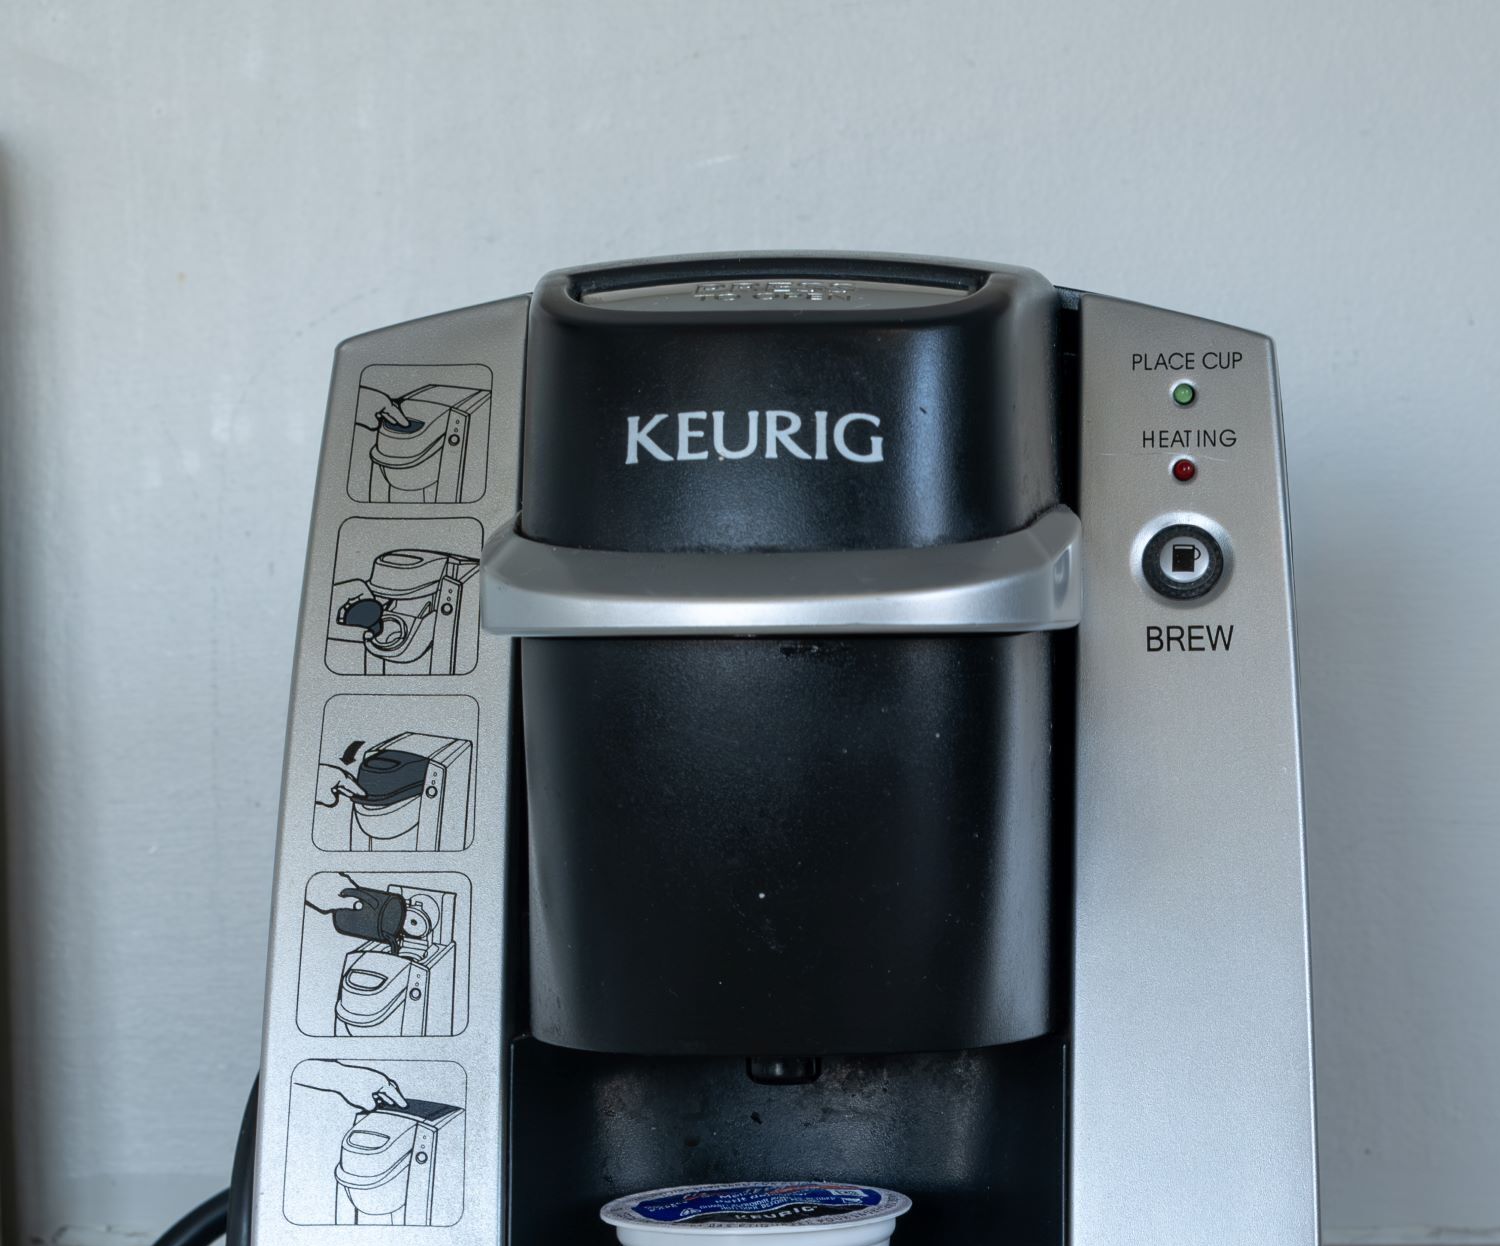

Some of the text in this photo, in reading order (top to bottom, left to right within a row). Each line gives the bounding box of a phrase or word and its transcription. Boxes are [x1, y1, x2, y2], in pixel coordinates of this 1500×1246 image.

[1131, 350, 1244, 371] PLACE CUP
[625, 409, 885, 465] KEURIG
[1142, 428, 1238, 449] HEATING
[1146, 623, 1235, 653] BREW
